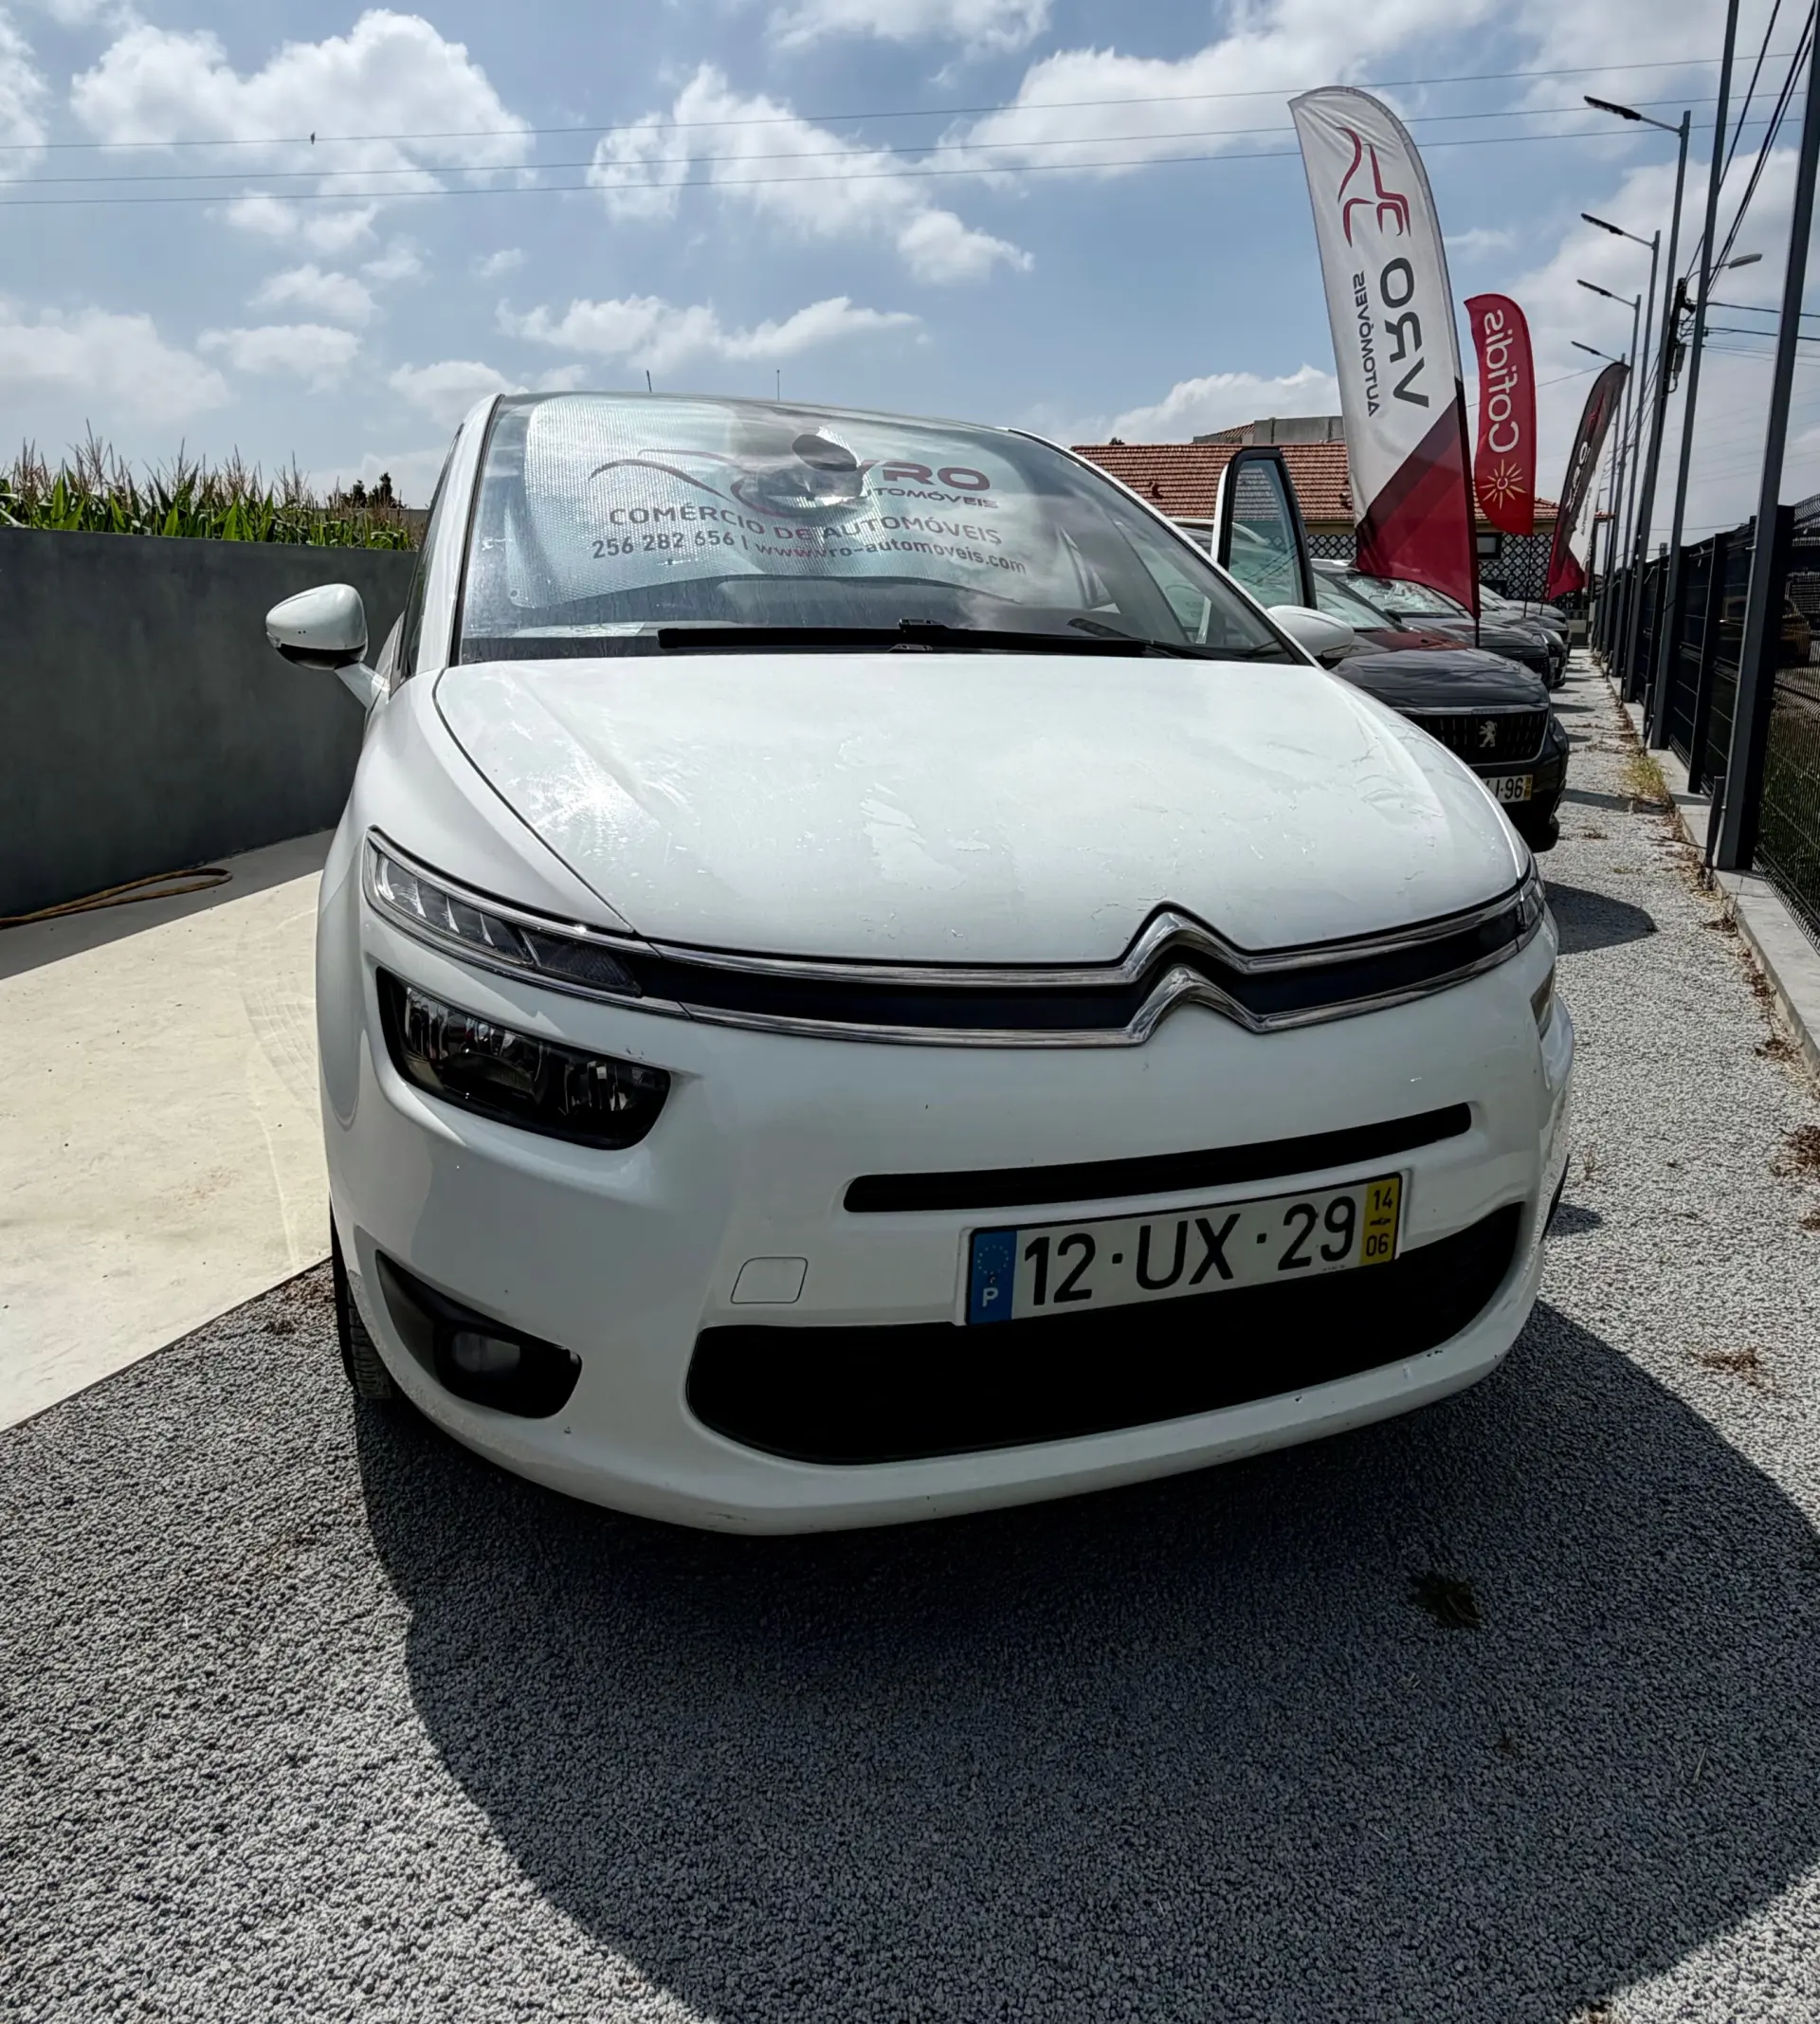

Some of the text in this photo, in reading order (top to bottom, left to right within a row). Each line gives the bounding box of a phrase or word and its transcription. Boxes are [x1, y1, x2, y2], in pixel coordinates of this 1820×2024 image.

[610, 502, 1003, 545] COMÉRCIO DE AUTOMÓVEIS
[592, 538, 634, 558] 256
[643, 532, 684, 552] 282
[694, 530, 735, 546] 656
[1373, 1186, 1393, 1212] 14
[1365, 1232, 1390, 1257] 06
[982, 1286, 999, 1307] P
